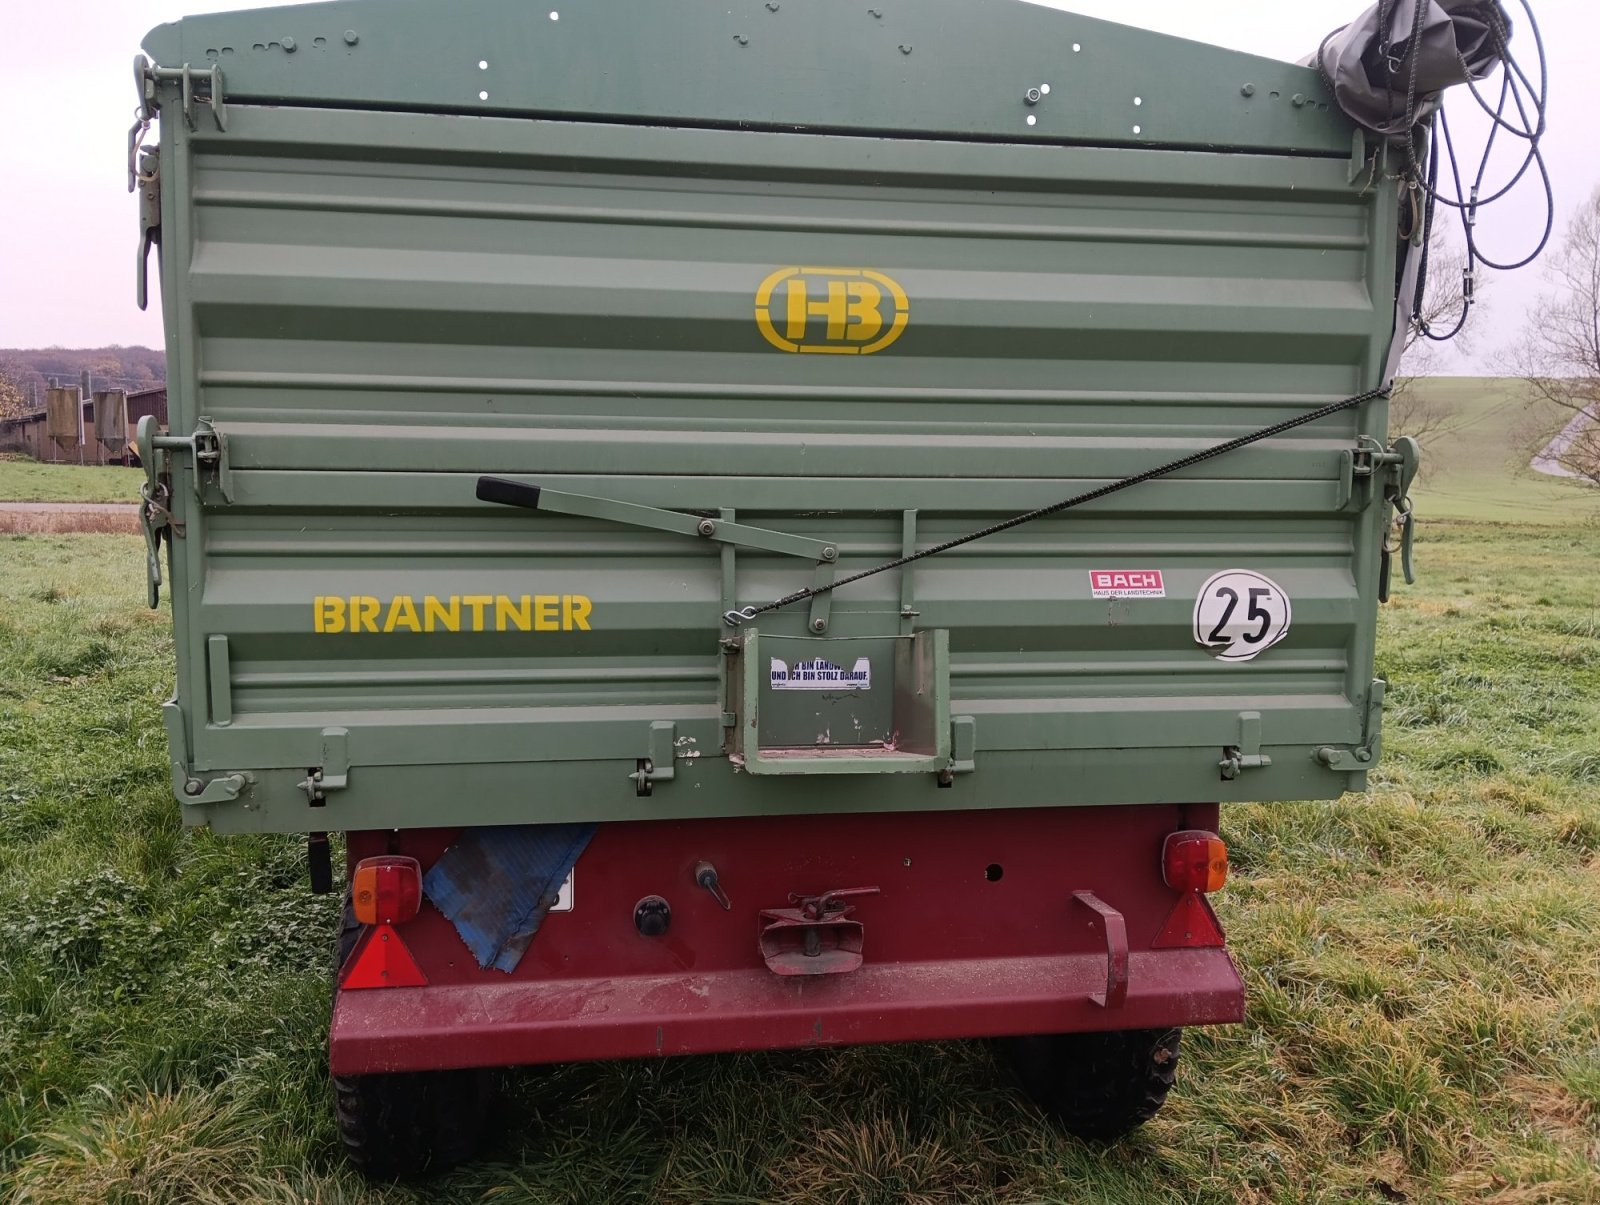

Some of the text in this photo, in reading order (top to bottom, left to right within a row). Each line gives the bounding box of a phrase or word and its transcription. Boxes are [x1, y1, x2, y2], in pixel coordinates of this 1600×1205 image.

[786, 280, 883, 340] HB
[1097, 574, 1157, 587] BACH
[313, 595, 592, 633] BRANTNER
[1208, 587, 1272, 644] 25
[771, 671, 787, 681] UND
[788, 671, 801, 681] CH
[803, 671, 815, 681] BIN
[817, 671, 838, 681] STOLZ
